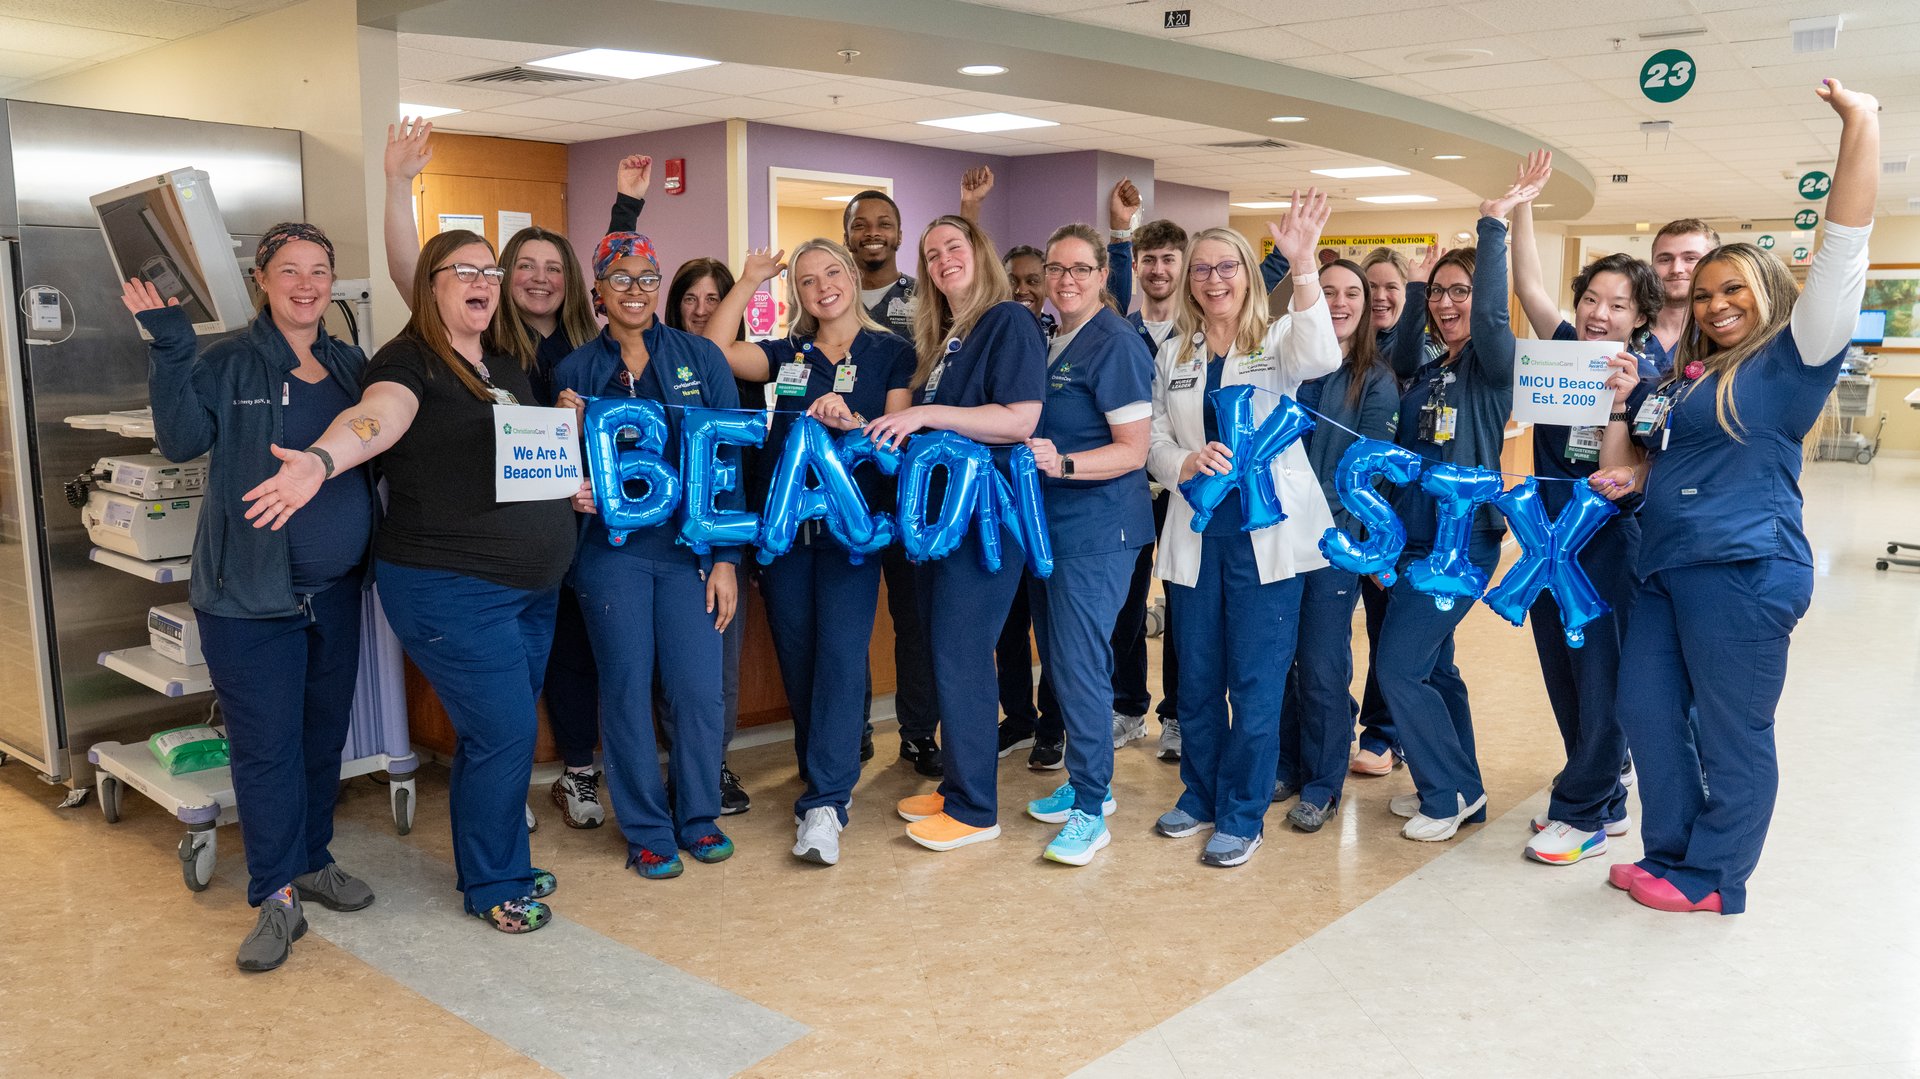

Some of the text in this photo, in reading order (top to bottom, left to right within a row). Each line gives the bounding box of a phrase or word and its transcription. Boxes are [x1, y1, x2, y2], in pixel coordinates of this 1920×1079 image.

[1176, 13, 1187, 25] 20
[1644, 61, 1692, 88] 23
[1801, 177, 1829, 192] 24
[1796, 213, 1817, 224] 25
[753, 294, 769, 302] STOP
[1519, 375, 1554, 388] MICU
[1532, 393, 1596, 406] Est. 2009
[513, 446, 568, 460] We Are A
[1568, 446, 1597, 454] REGISTERED
[503, 464, 578, 479] Beacon Unit
[1317, 435, 1620, 648] SIX
